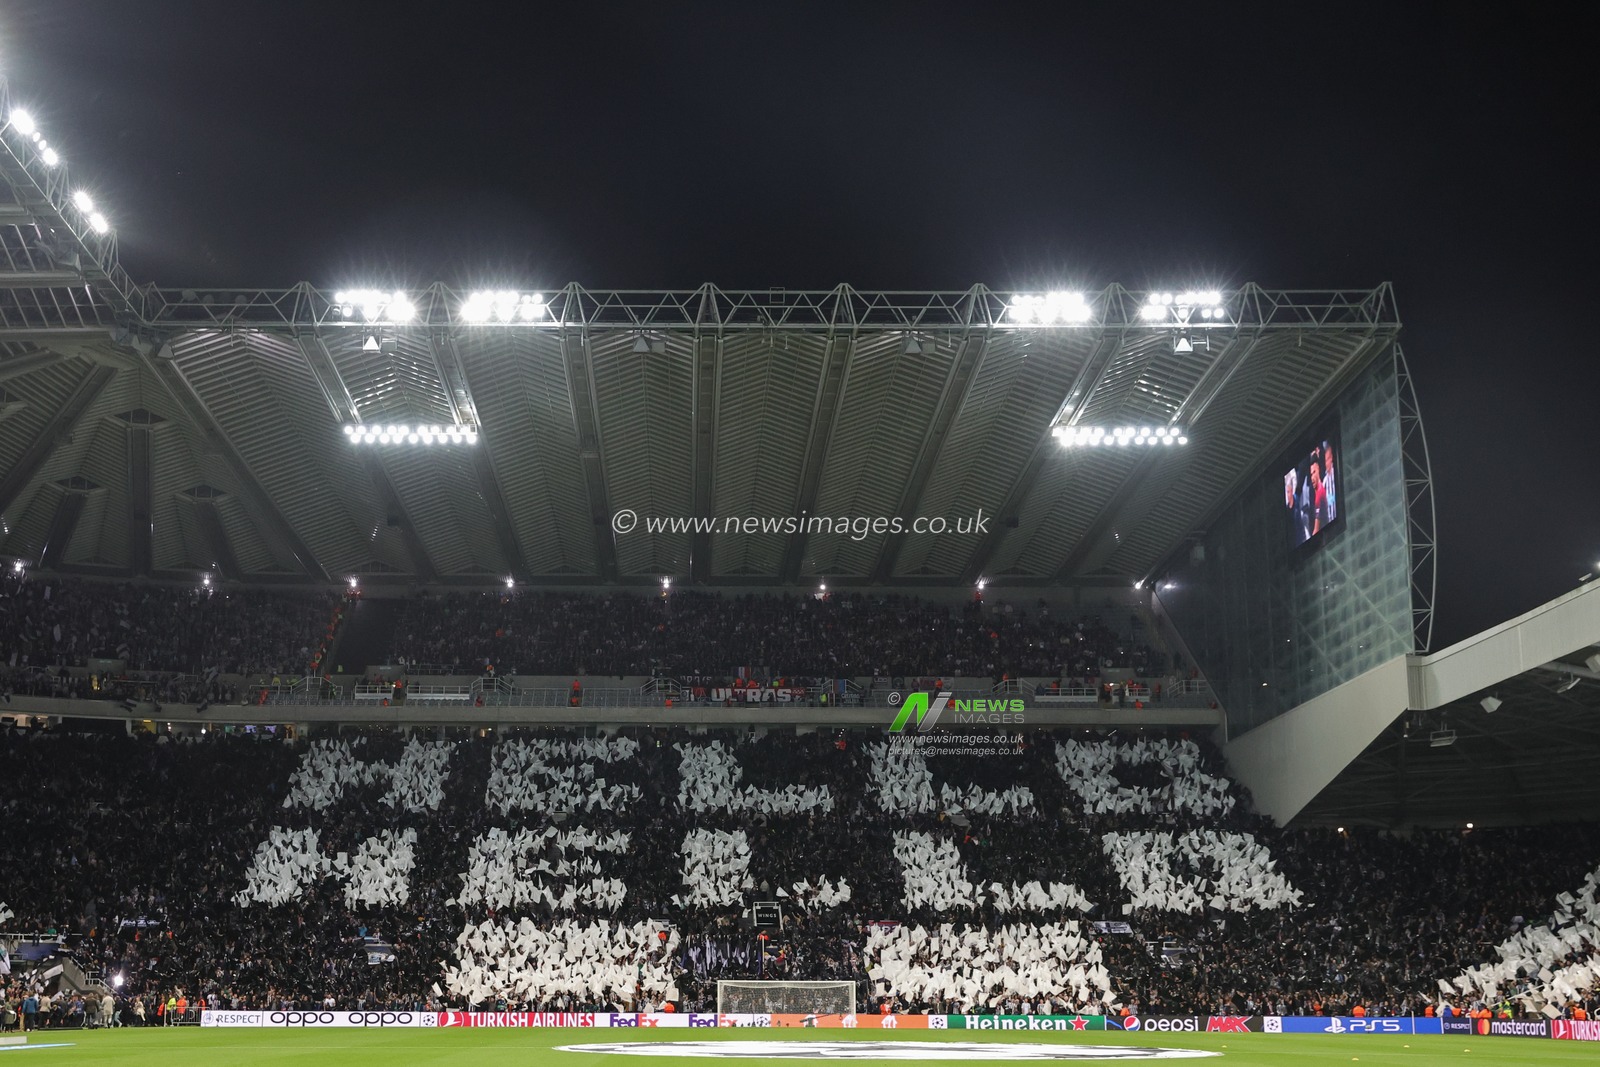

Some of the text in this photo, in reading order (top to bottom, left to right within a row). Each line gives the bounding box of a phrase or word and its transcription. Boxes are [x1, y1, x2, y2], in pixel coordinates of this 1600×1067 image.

[711, 688, 792, 702] ULTRAS
[217, 1014, 261, 1024] RESPECT
[270, 1011, 334, 1027] oppo
[348, 1012, 413, 1027] oppo
[468, 1012, 595, 1028] TURKISH AIRLINES
[610, 1013, 660, 1028] FedEx
[688, 1014, 736, 1028] FedEx
[964, 1015, 1067, 1031] Heineken
[1144, 1015, 1253, 1033] pepsi MAX
[1349, 1019, 1401, 1032] PS5
[1491, 1019, 1546, 1036] mastercard
